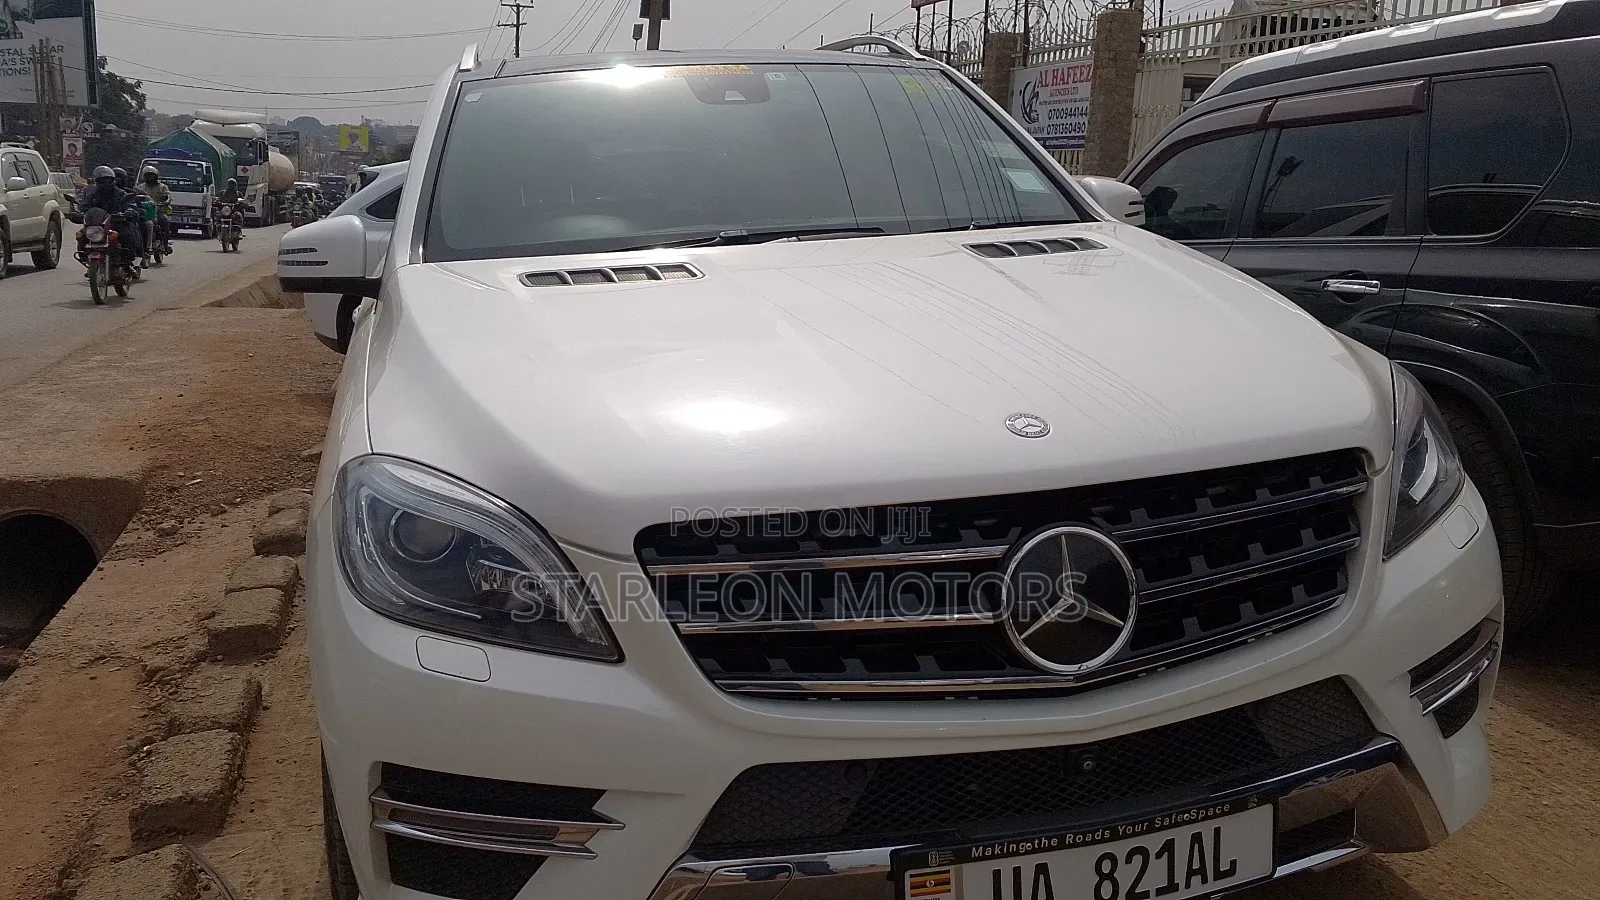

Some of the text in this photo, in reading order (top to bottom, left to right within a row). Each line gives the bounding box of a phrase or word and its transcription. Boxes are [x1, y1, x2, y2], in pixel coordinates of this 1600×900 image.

[1037, 64, 1092, 88] AL HAFEEZ
[1048, 106, 1088, 120] 0700944144
[971, 842, 1026, 858] Making
[1034, 837, 1058, 849] the
[1065, 828, 1110, 845] Roads
[1117, 821, 1149, 836] Your
[1154, 812, 1184, 828] Safe
[1190, 803, 1231, 821] Space
[1093, 826, 1238, 900] 821AL
